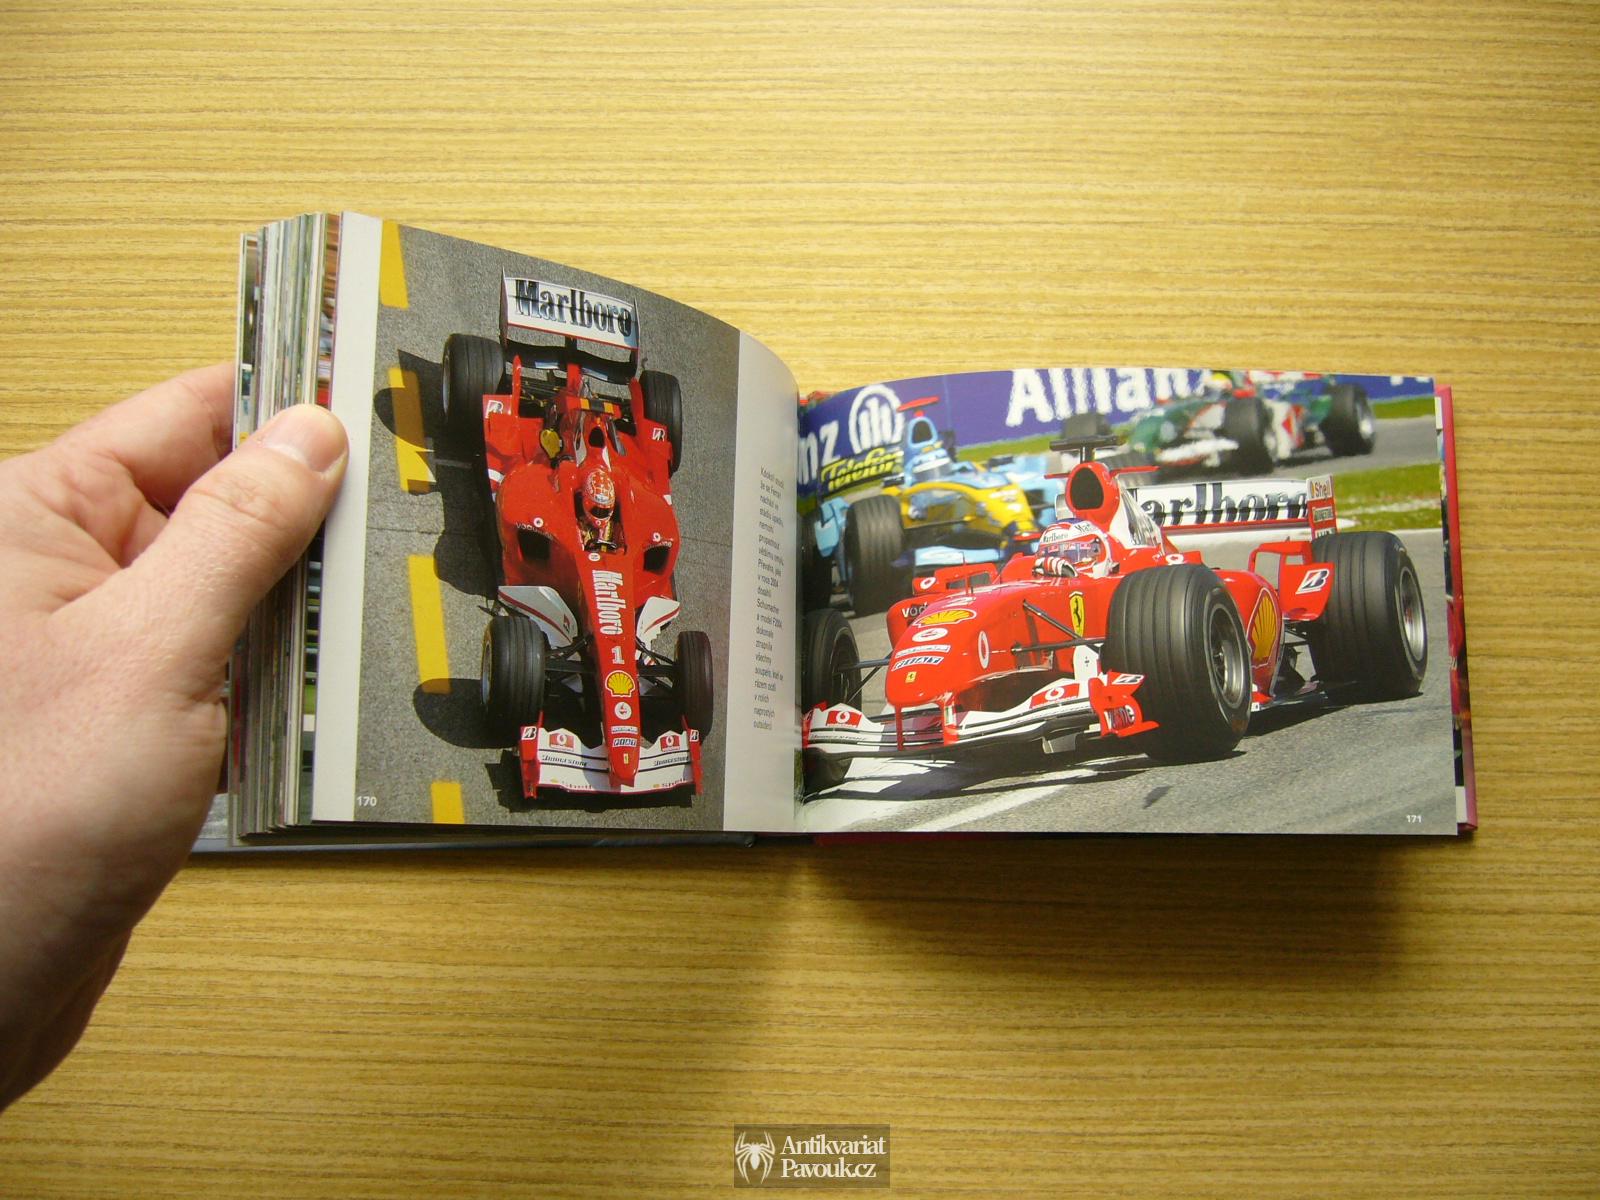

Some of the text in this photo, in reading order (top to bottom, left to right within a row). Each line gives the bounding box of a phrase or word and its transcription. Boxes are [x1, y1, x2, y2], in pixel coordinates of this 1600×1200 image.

[515, 279, 632, 337] Marlboro
[1127, 483, 1307, 528] arlboro
[592, 570, 626, 635] Marlboro
[611, 646, 625, 665] 1
[357, 796, 377, 806] 170
[1406, 814, 1422, 823] 171
